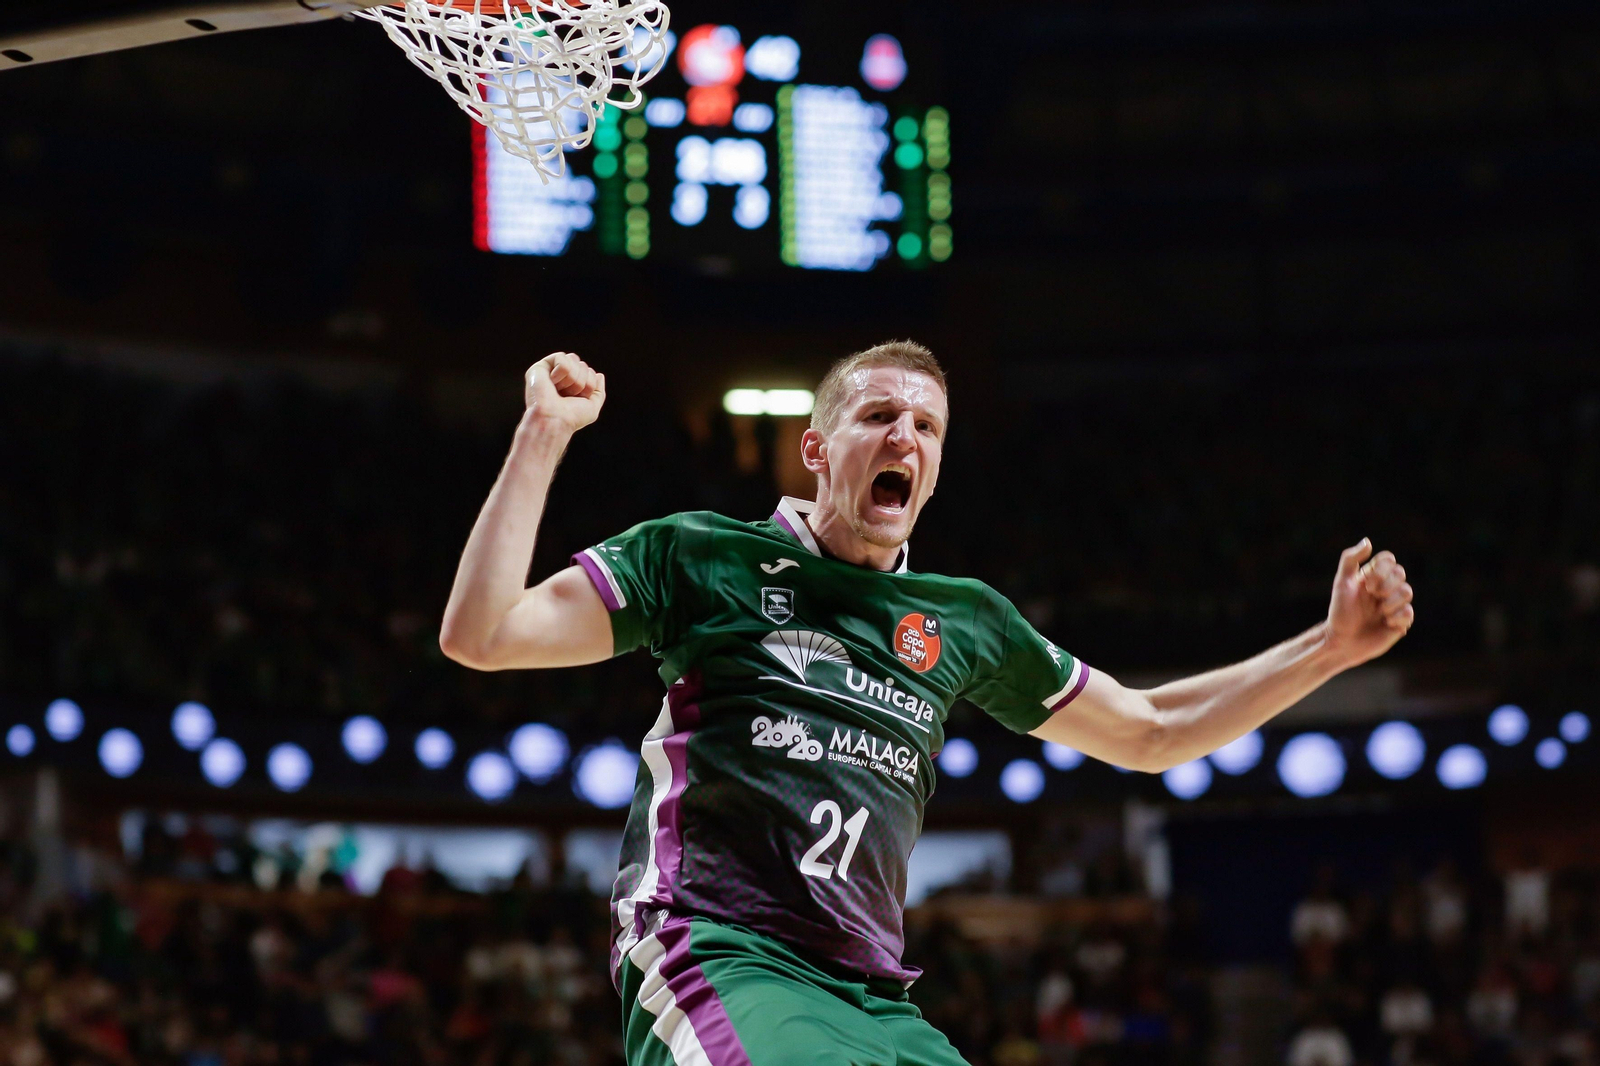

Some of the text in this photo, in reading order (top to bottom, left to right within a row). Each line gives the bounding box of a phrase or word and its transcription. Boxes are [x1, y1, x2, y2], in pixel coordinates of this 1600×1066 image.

[902, 632, 925, 649] Copa
[907, 628, 920, 638] acb
[911, 646, 927, 661] Rey
[845, 667, 934, 722] Unicaja
[828, 726, 919, 776] MÁLAGA
[827, 752, 868, 768] EUROPEAN
[893, 769, 902, 779] OF
[800, 799, 870, 882] 21
